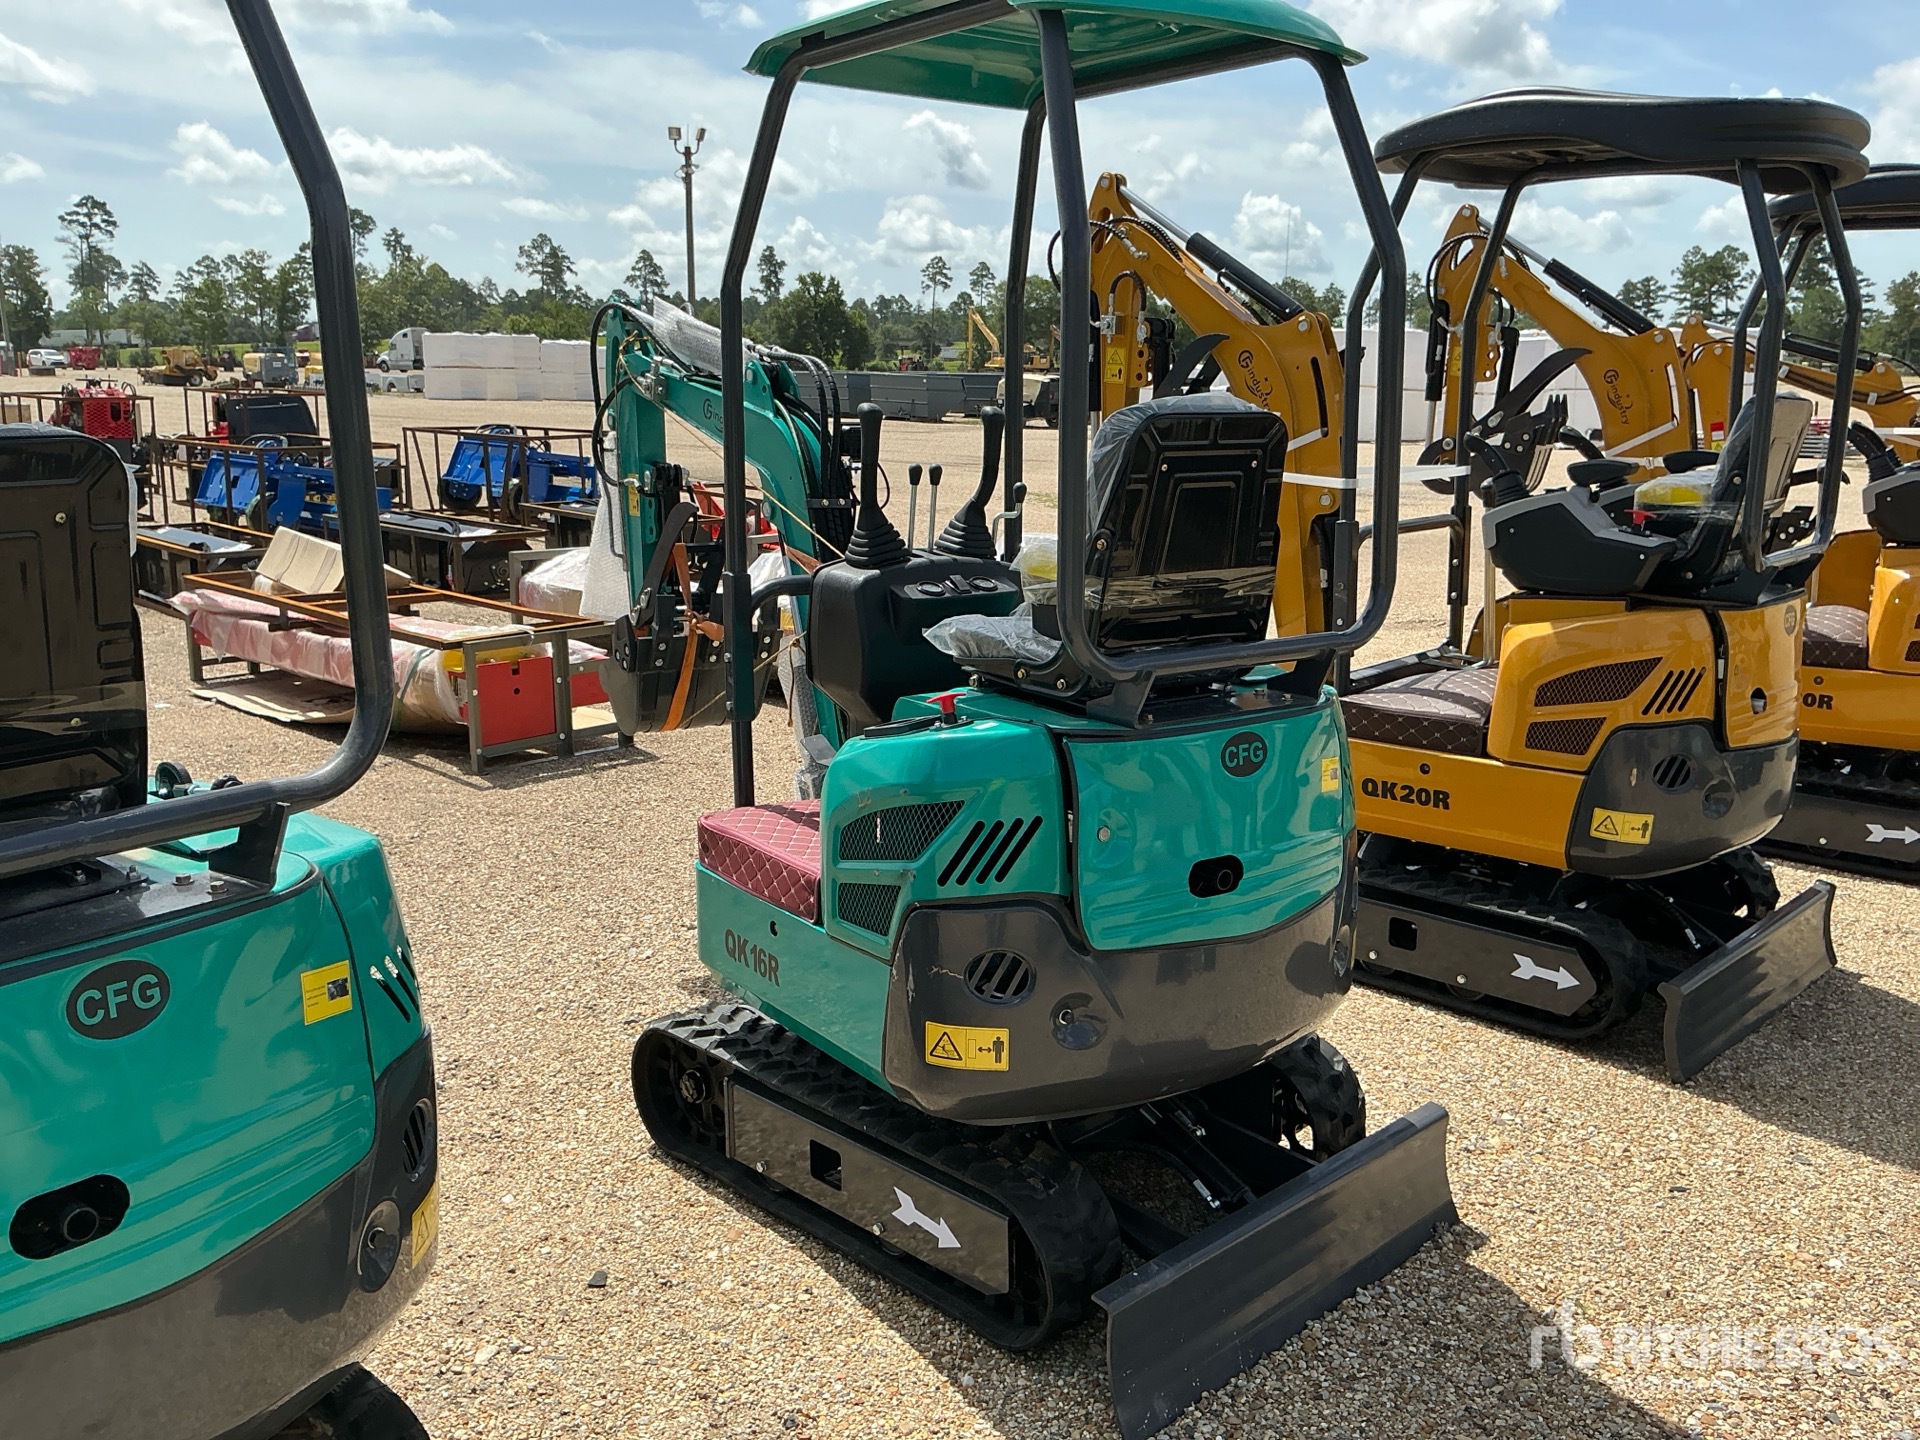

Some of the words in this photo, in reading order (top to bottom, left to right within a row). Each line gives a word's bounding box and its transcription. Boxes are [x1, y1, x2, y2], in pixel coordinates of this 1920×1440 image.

[1800, 692, 1834, 710] 0R
[1225, 741, 1264, 768] CFG
[1361, 777, 1450, 810] QK20R
[724, 928, 780, 987] QK16R
[76, 973, 162, 1026] CFG
